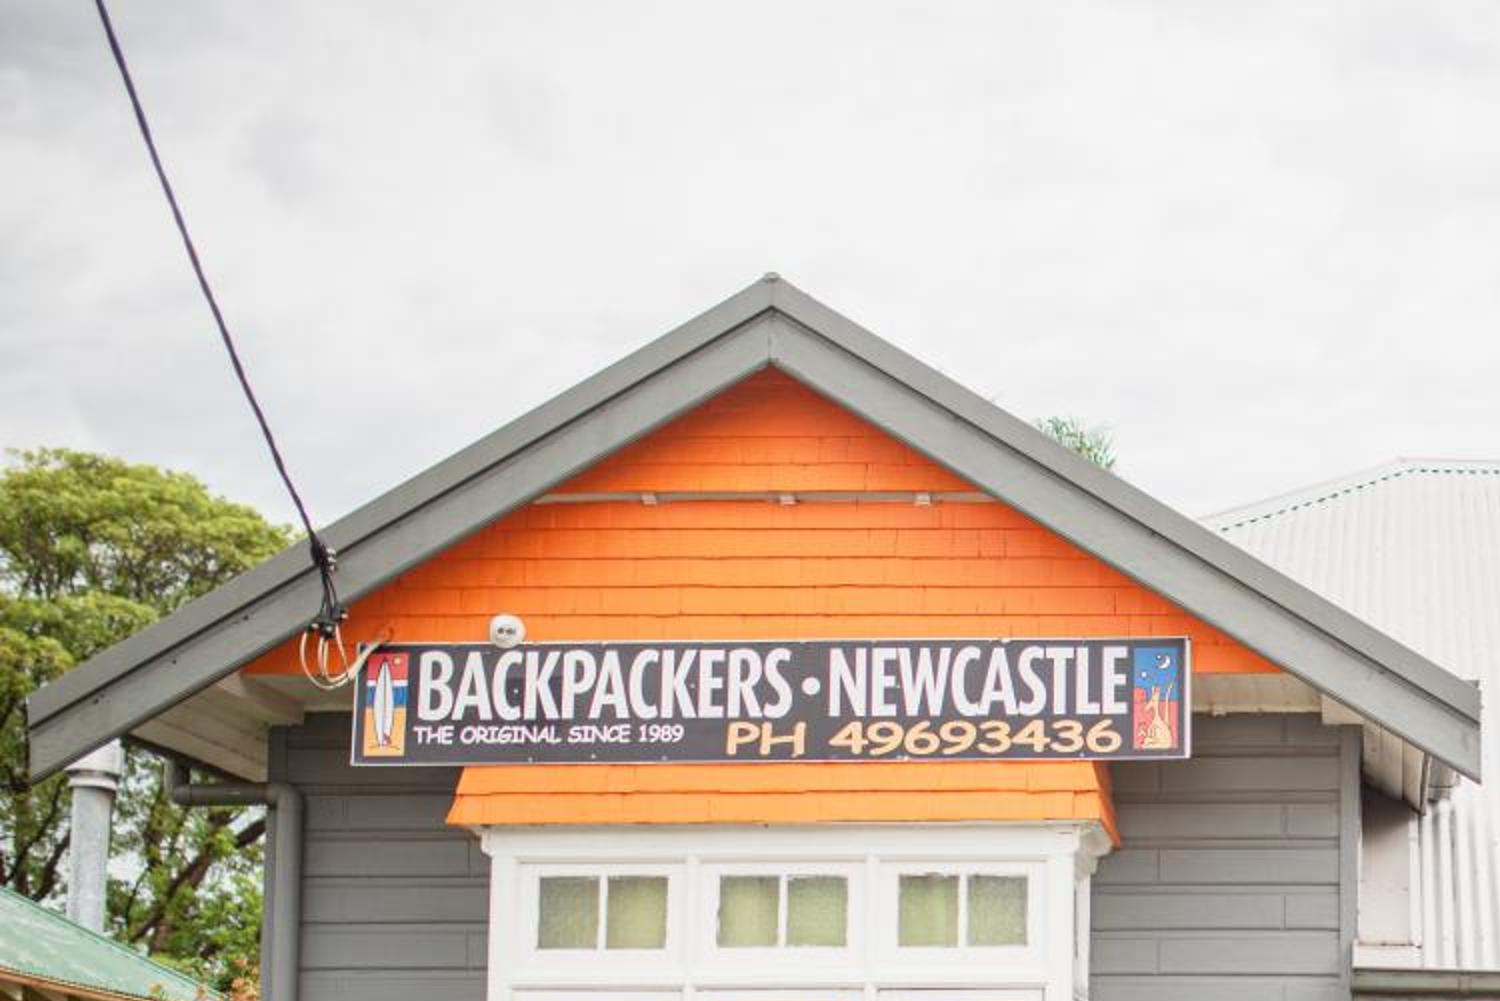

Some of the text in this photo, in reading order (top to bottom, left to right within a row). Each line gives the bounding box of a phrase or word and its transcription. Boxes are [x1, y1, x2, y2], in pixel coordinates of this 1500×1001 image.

[417, 646, 1129, 721] BACKPACKERS NEWCASTLE
[413, 723, 685, 745] THE ORIGINAL SINCE 1989
[725, 718, 1122, 758] PH 49693436
